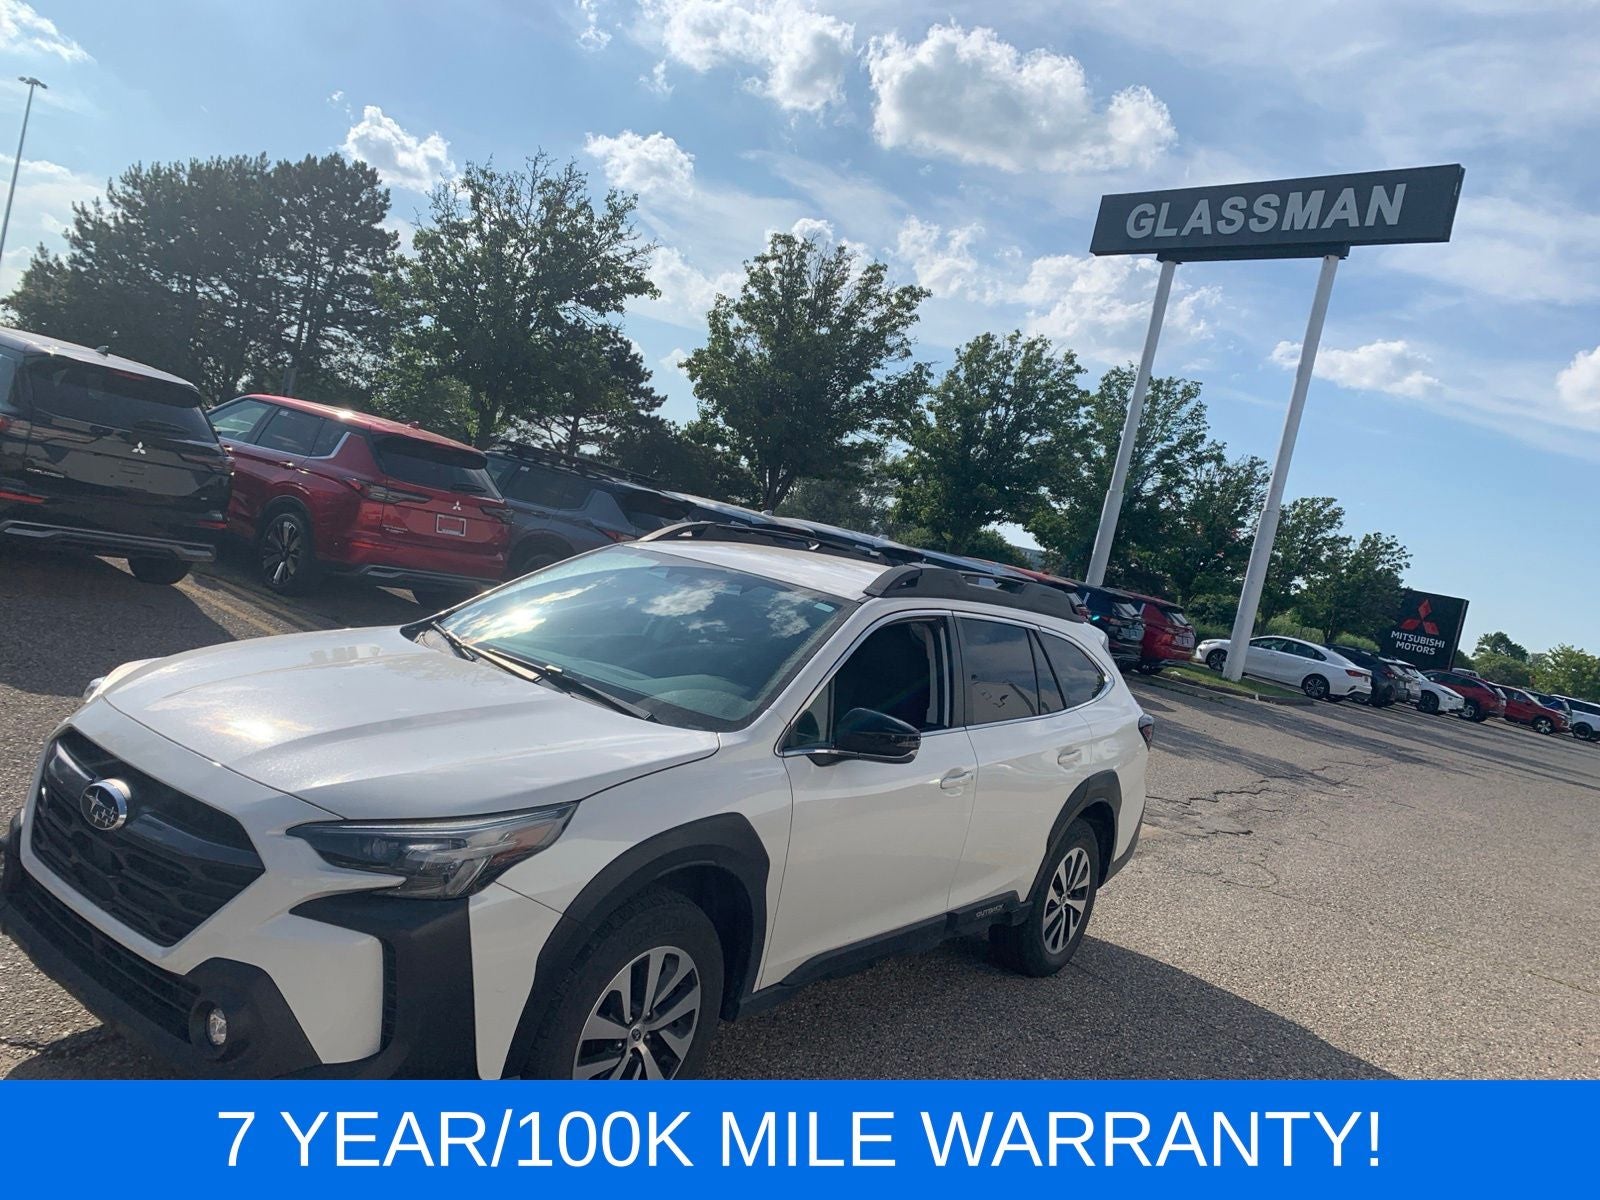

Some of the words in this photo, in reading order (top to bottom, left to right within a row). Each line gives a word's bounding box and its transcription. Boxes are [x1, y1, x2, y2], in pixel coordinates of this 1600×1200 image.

[1126, 183, 1406, 239] GLASSMAN
[1390, 630, 1446, 649] MITSUBISHI
[1395, 641, 1436, 656] MOTORS
